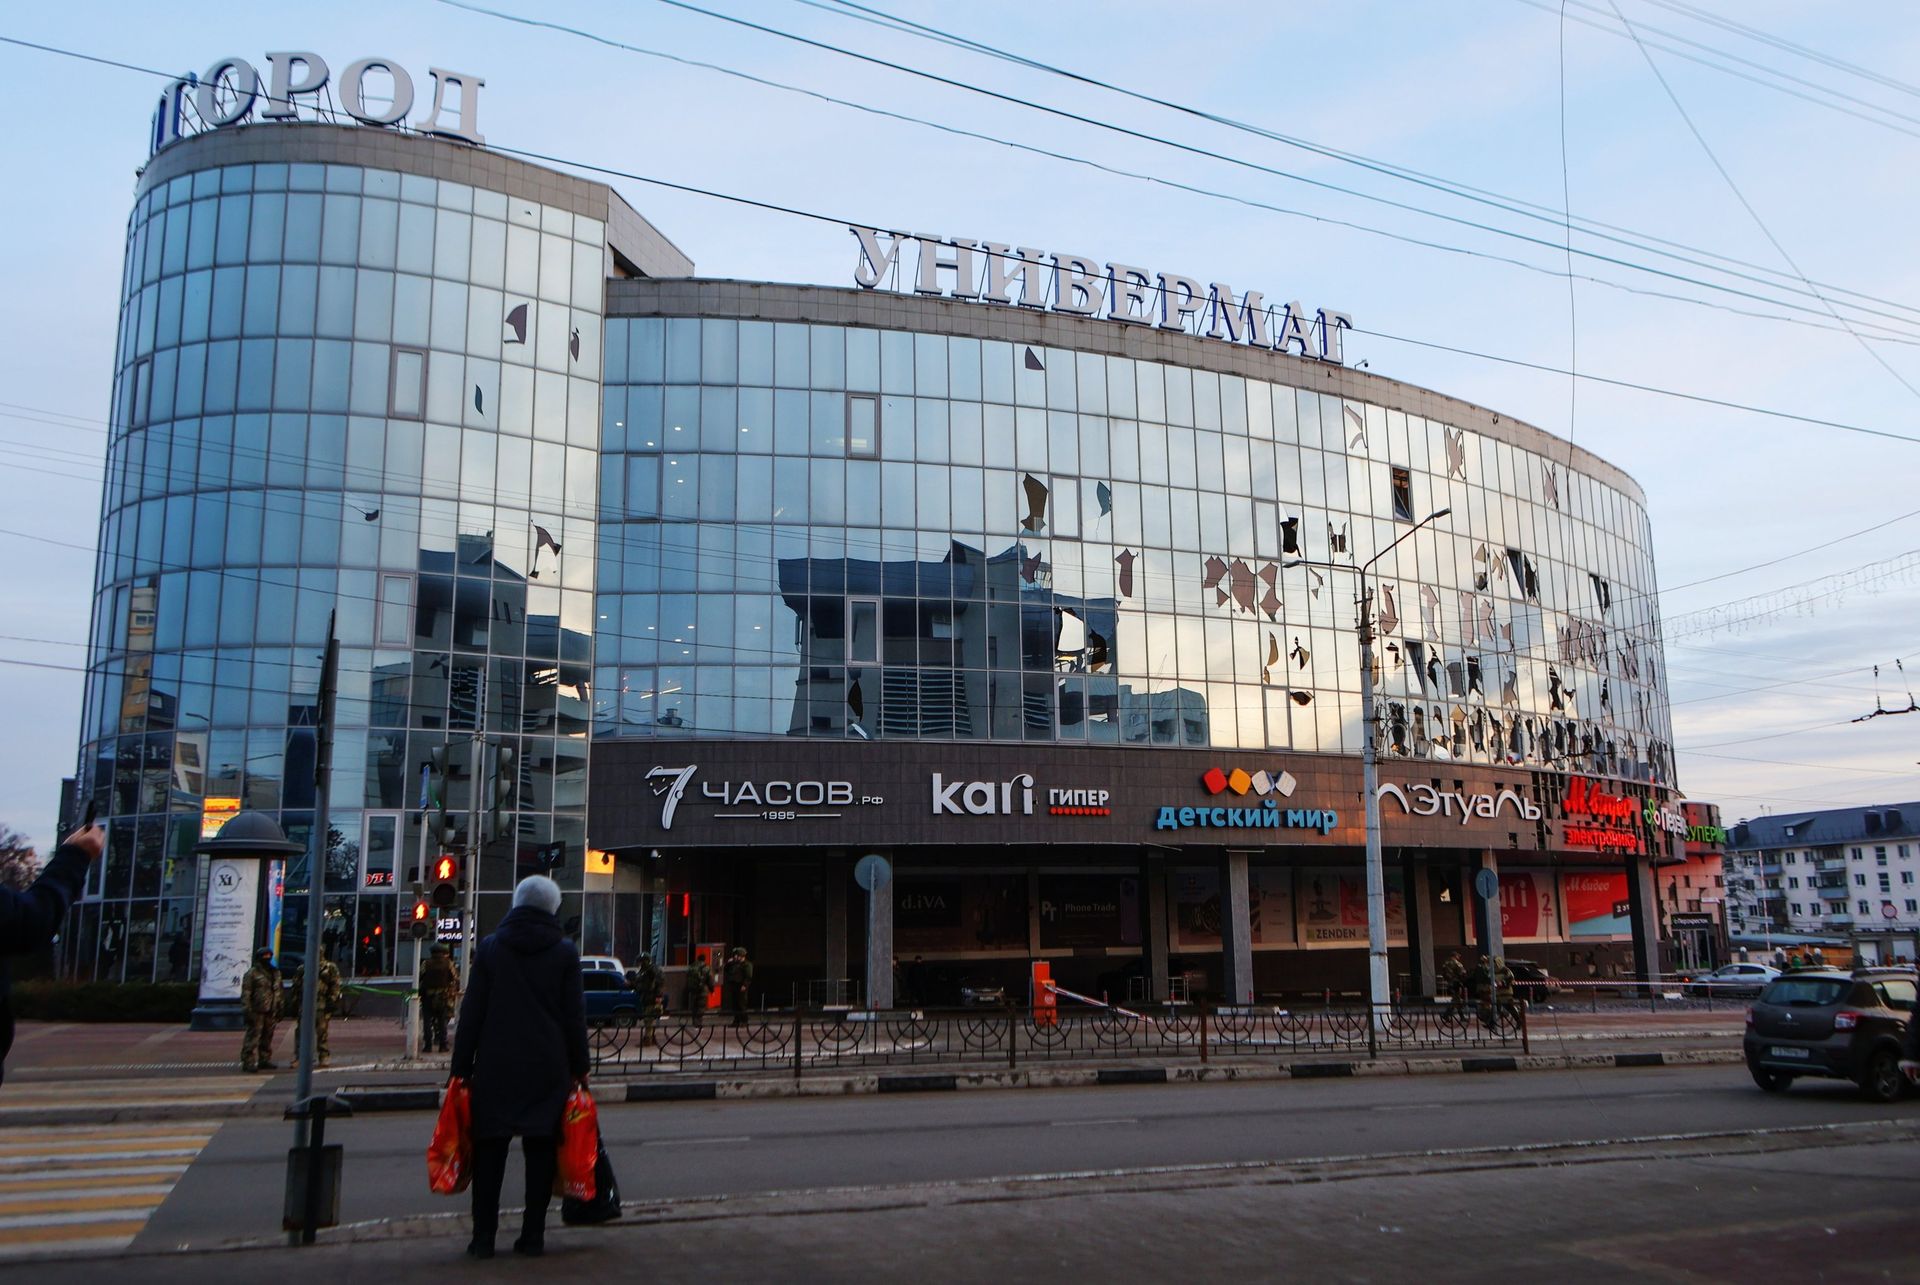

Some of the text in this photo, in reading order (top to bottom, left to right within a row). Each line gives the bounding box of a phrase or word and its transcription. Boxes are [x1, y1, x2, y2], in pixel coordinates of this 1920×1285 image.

[151, 50, 486, 150] ГОРОД
[849, 225, 1353, 364] УНИВЕРМАГ
[644, 764, 699, 830] 7
[932, 772, 1035, 816] kari
[1048, 788, 1111, 808] ГИПЕР
[761, 811, 796, 821] 1995
[1286, 809, 1339, 836] мир
[1315, 928, 1356, 940] ZENDEN
